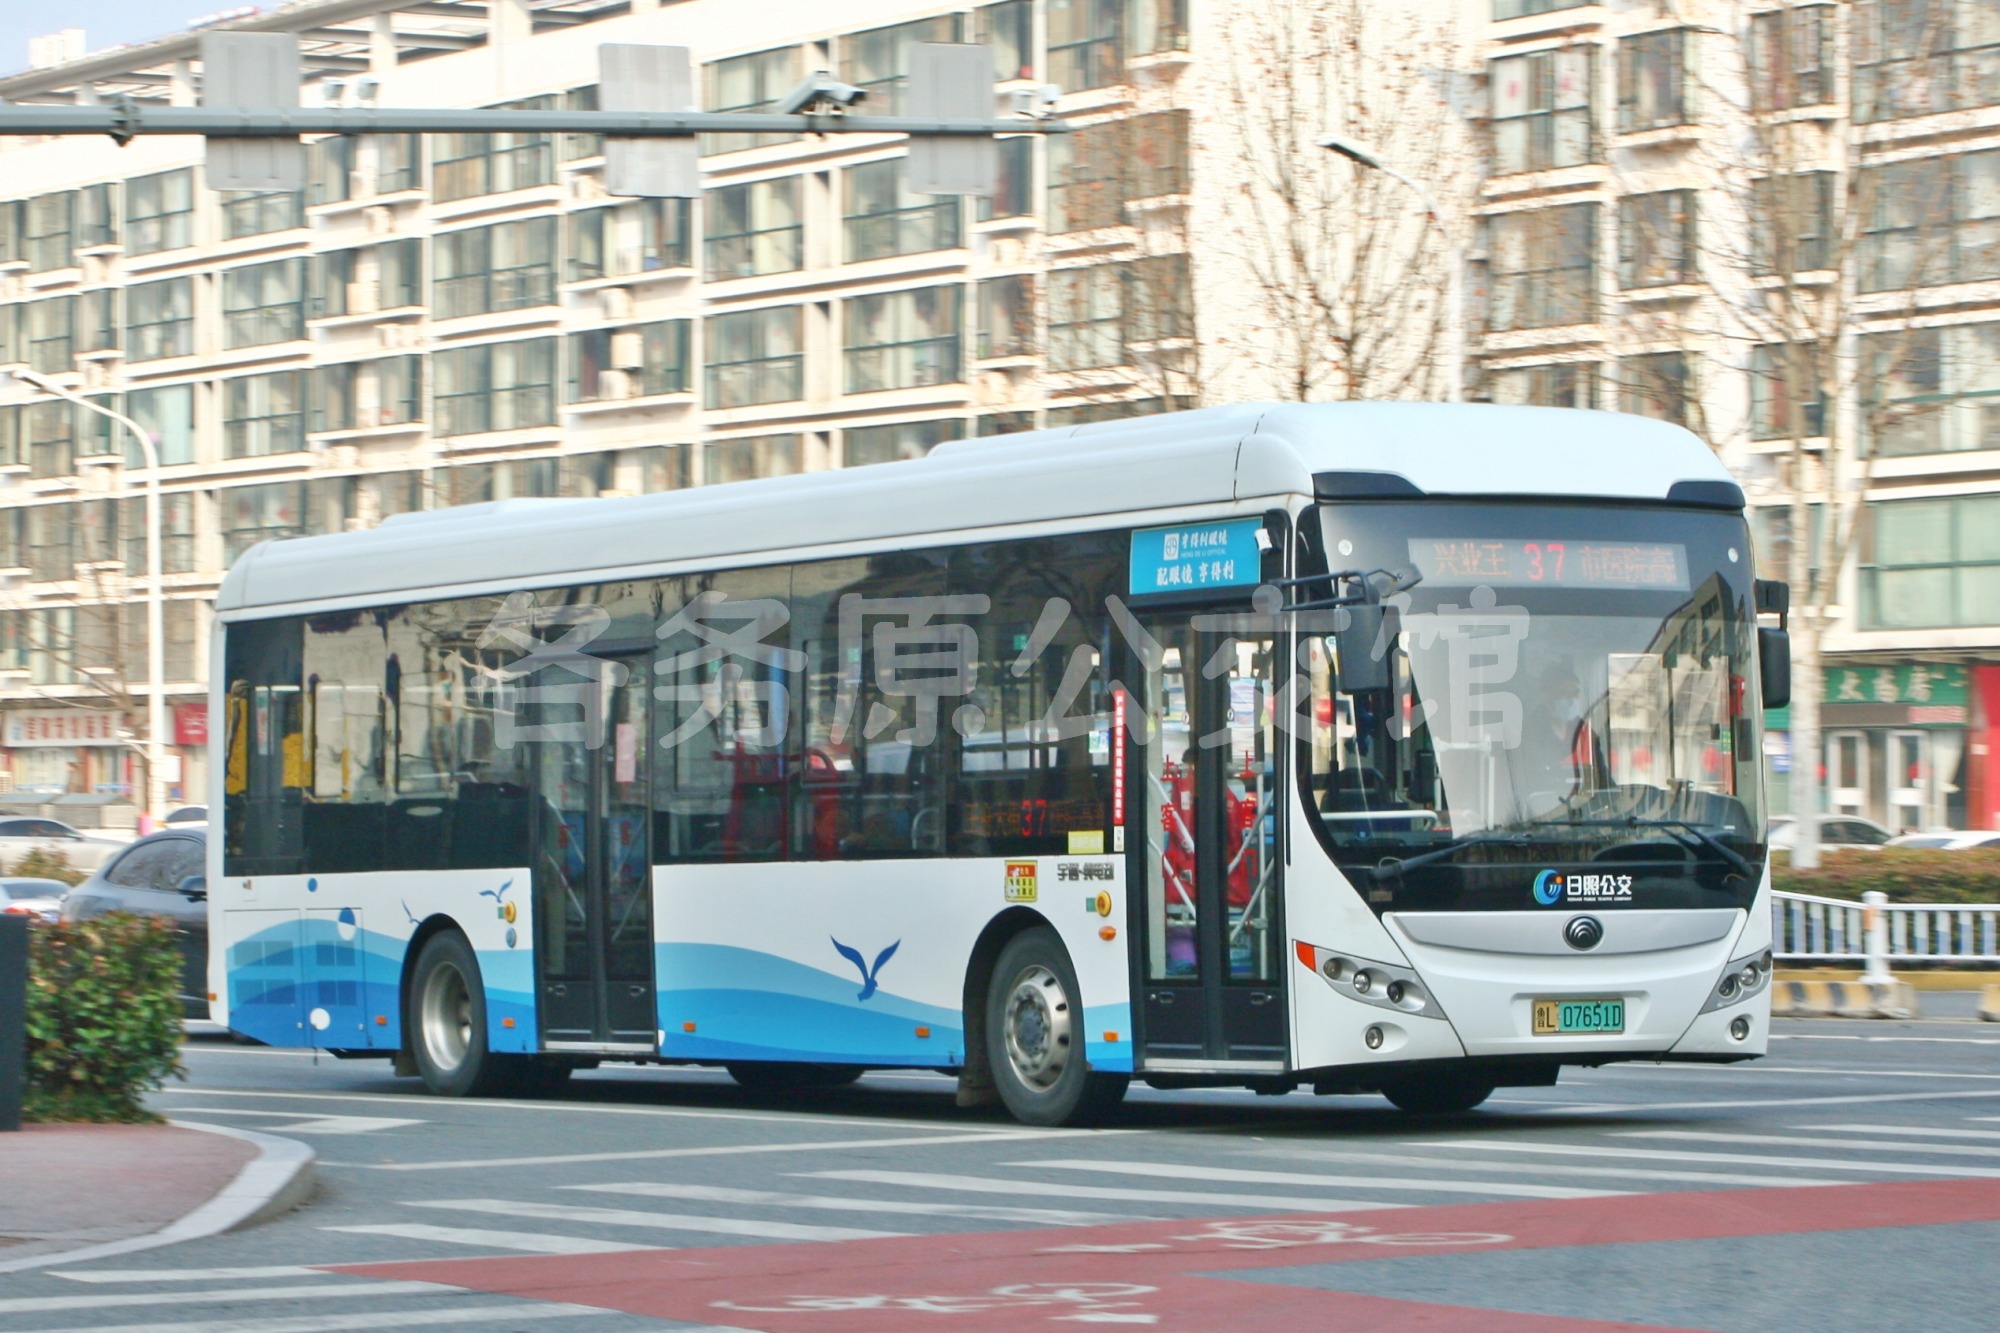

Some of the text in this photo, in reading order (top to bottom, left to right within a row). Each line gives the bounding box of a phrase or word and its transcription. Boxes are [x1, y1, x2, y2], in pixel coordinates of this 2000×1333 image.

[1156, 559, 1235, 586] 配眼镜 亨得利
[1522, 543, 1566, 581] 37
[1021, 799, 1048, 837] 37
[1566, 874, 1633, 896] 日照公交
